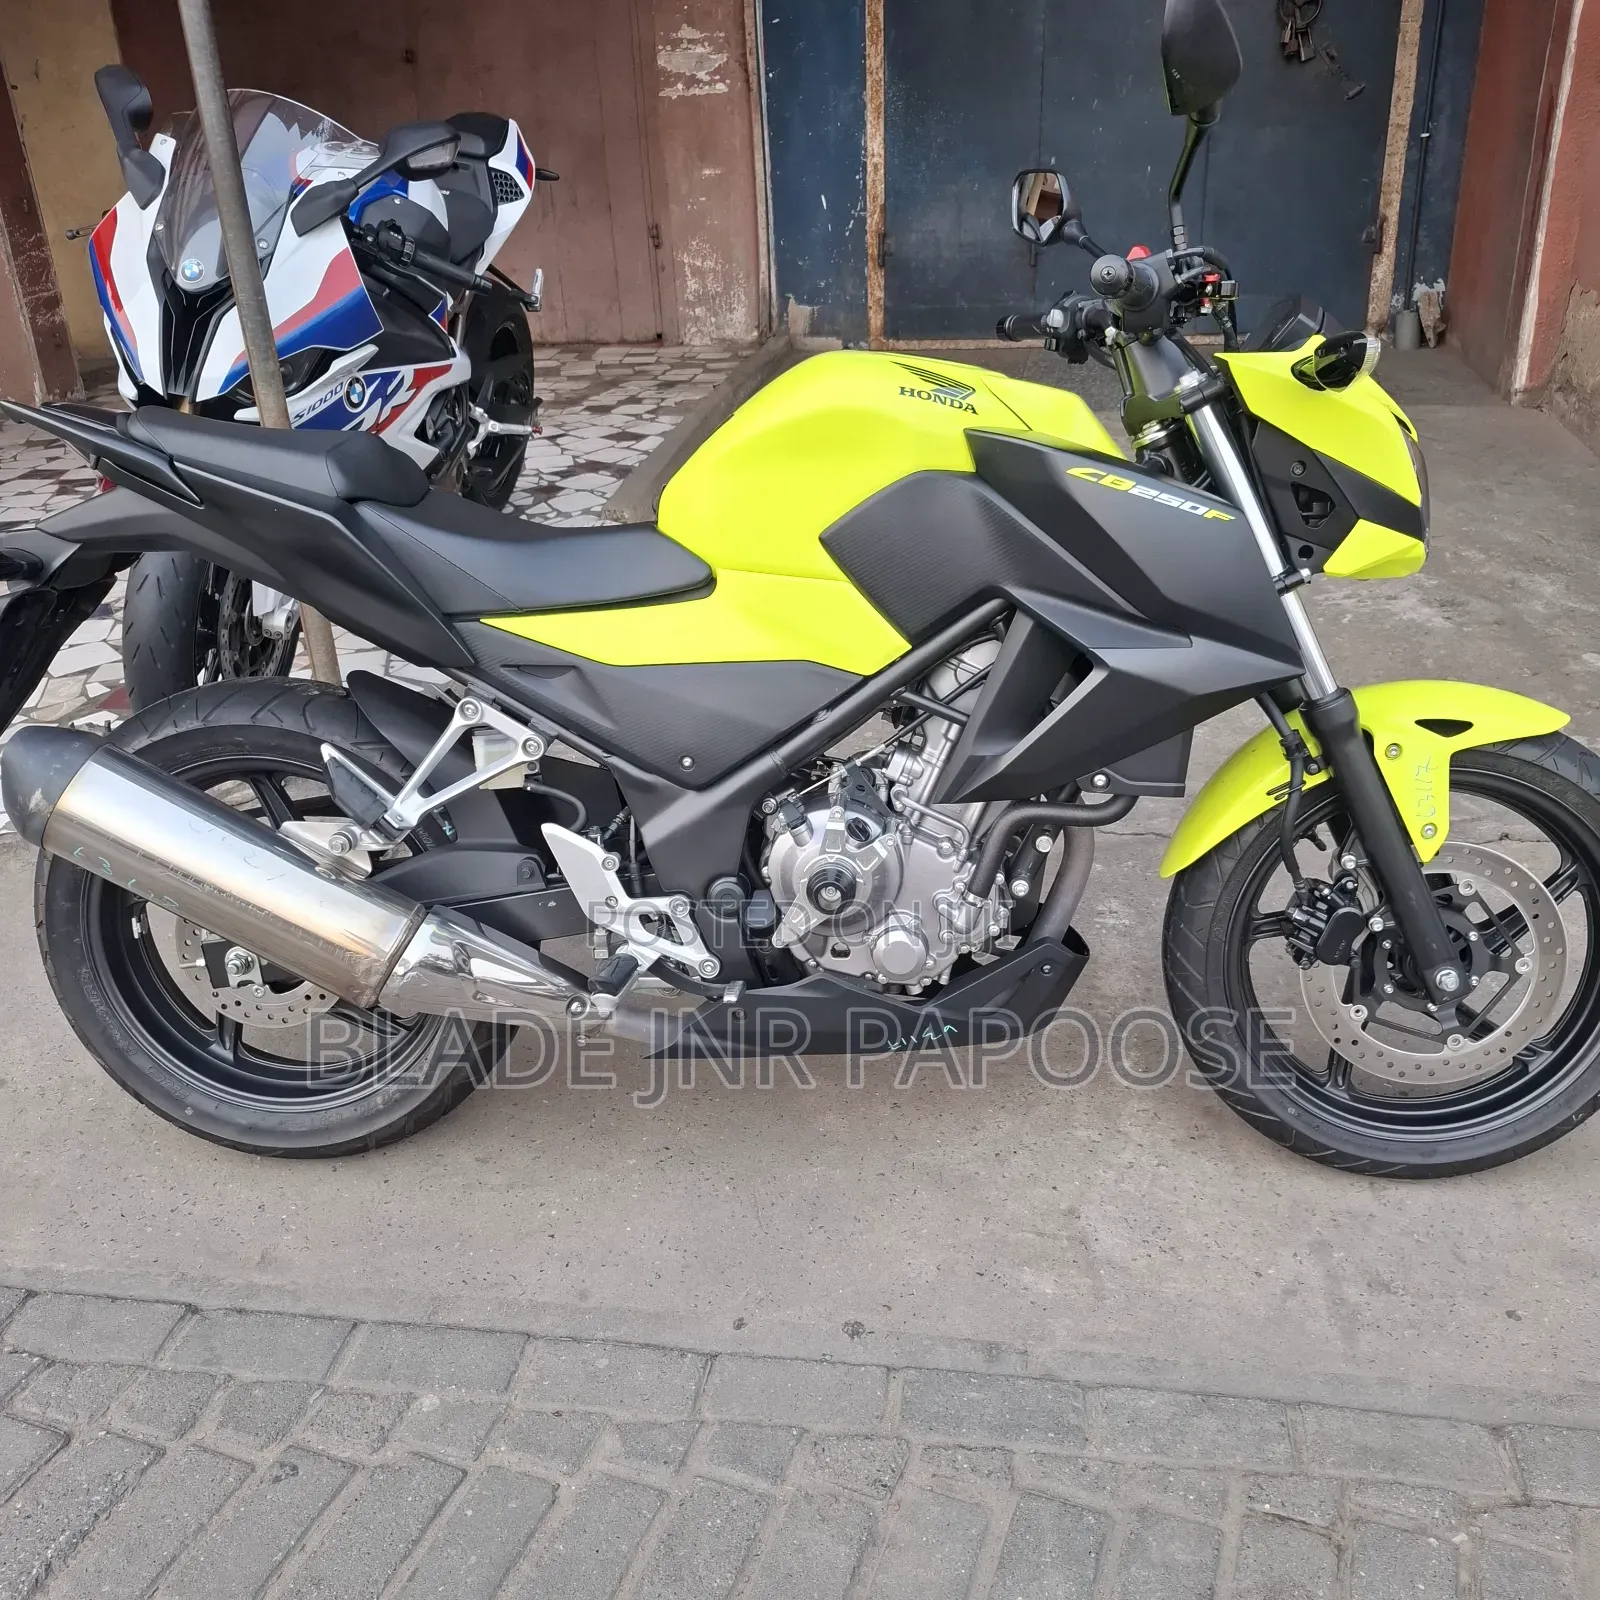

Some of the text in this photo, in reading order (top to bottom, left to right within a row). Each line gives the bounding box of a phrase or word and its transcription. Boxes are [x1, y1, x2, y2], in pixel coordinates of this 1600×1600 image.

[293, 381, 344, 421] S1000
[898, 386, 979, 415] HONDA
[1066, 467, 1236, 521] CB250F
